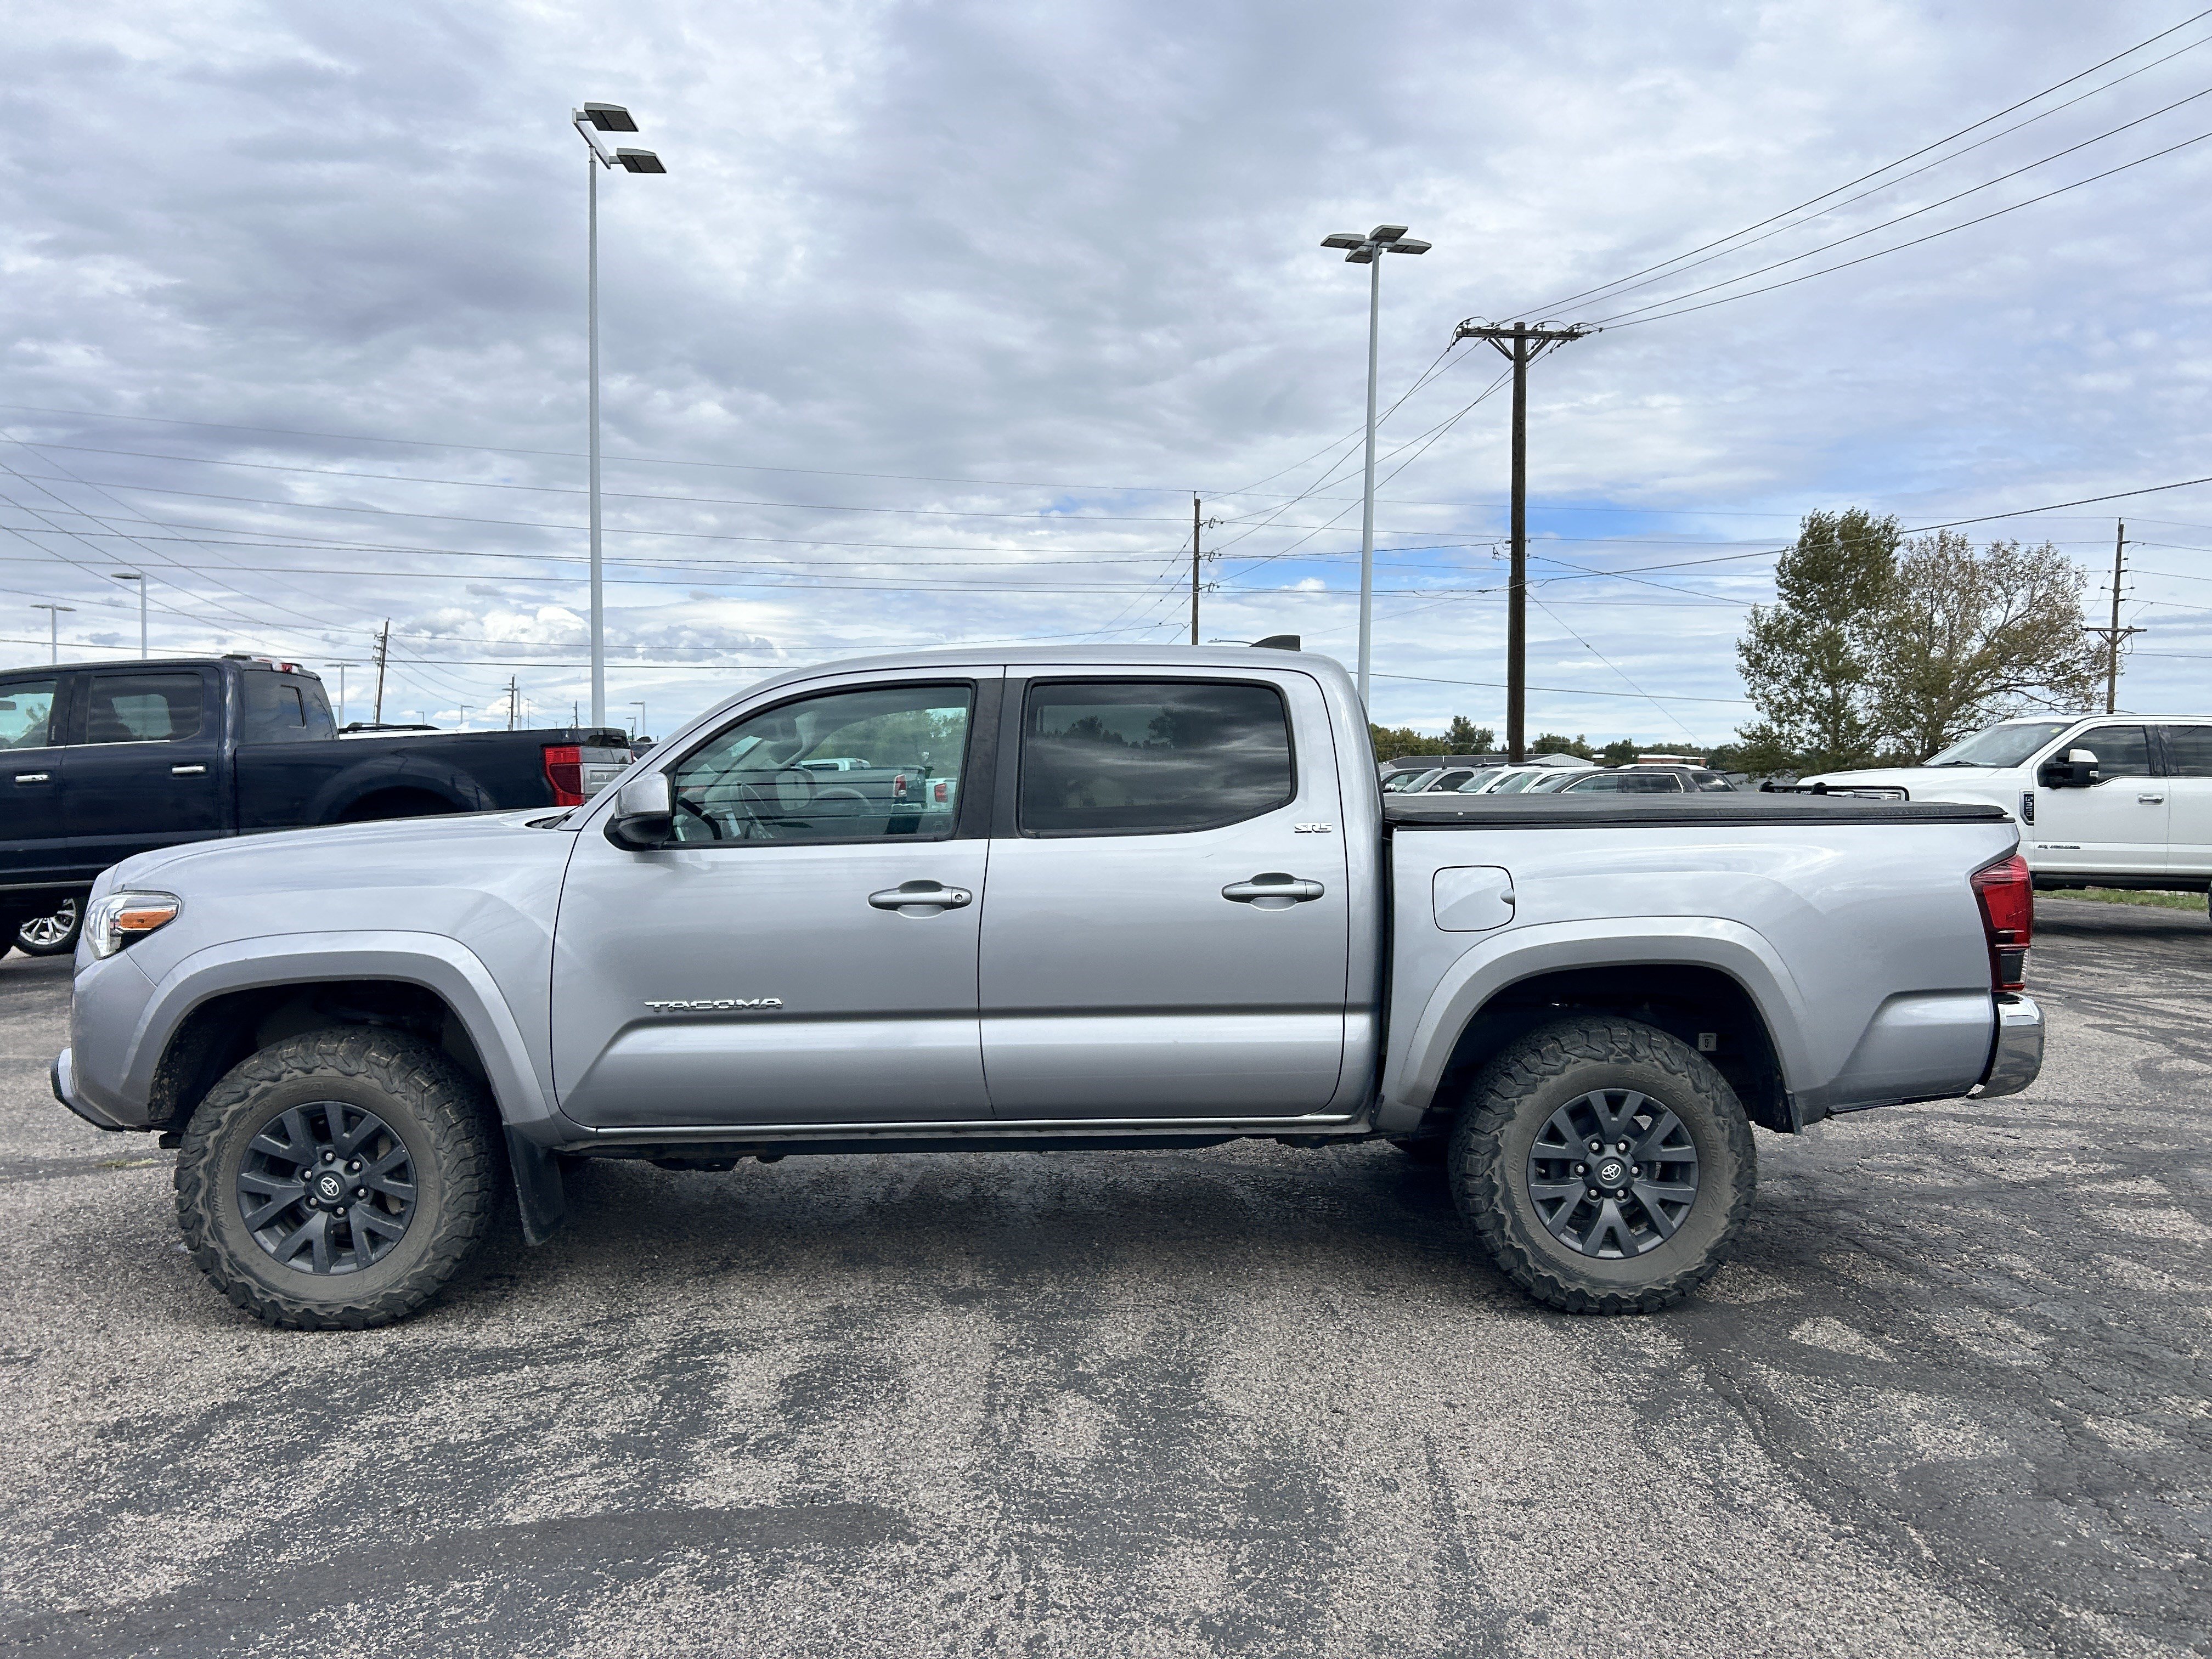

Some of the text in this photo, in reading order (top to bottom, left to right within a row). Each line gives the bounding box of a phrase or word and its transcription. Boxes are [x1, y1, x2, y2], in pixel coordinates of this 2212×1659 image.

[1295, 822, 1333, 833] SR5
[644, 997, 783, 1012] TACOMA
[1618, 1070, 1717, 1166] All-Terrain
